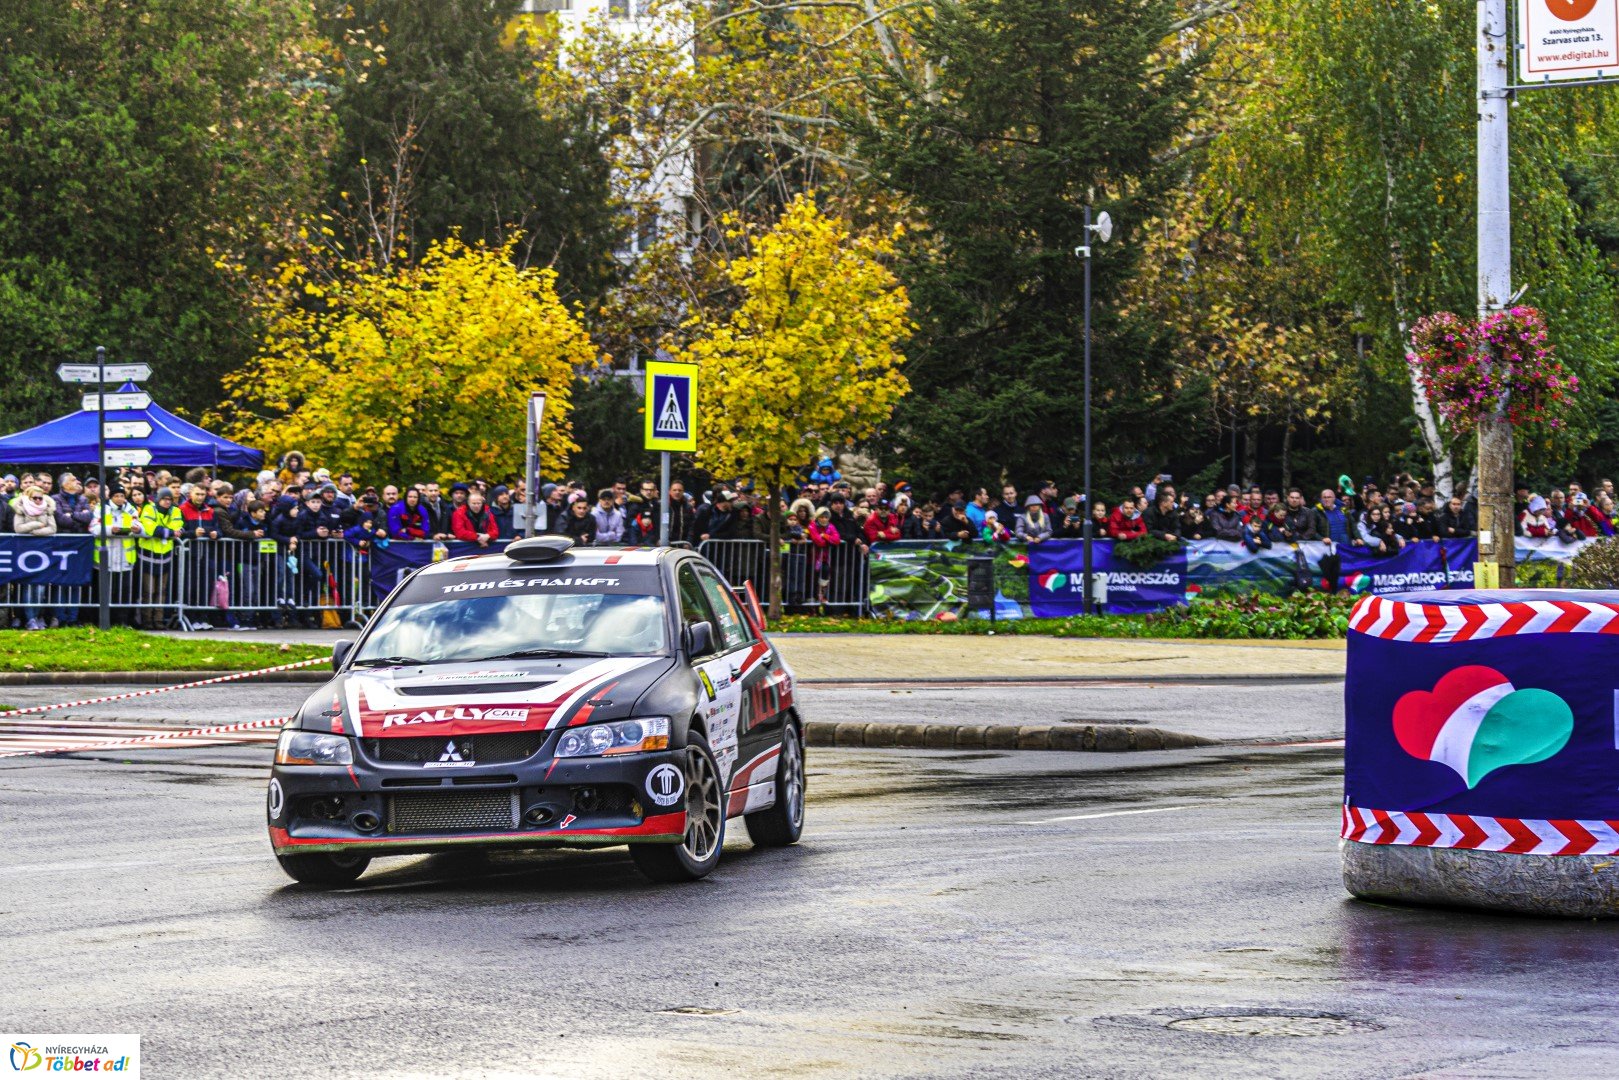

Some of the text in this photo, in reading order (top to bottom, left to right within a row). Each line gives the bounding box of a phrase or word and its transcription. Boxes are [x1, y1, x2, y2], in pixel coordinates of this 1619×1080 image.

[1542, 37, 1572, 45] Szarvas
[1573, 35, 1589, 43] utca
[1537, 50, 1609, 62] www.edigital.hu
[1070, 568, 1180, 585] MYARORSZÁG
[442, 577, 620, 594] TÓTH ÉS FIAI KFT.
[382, 707, 525, 728] RALLY CAFE
